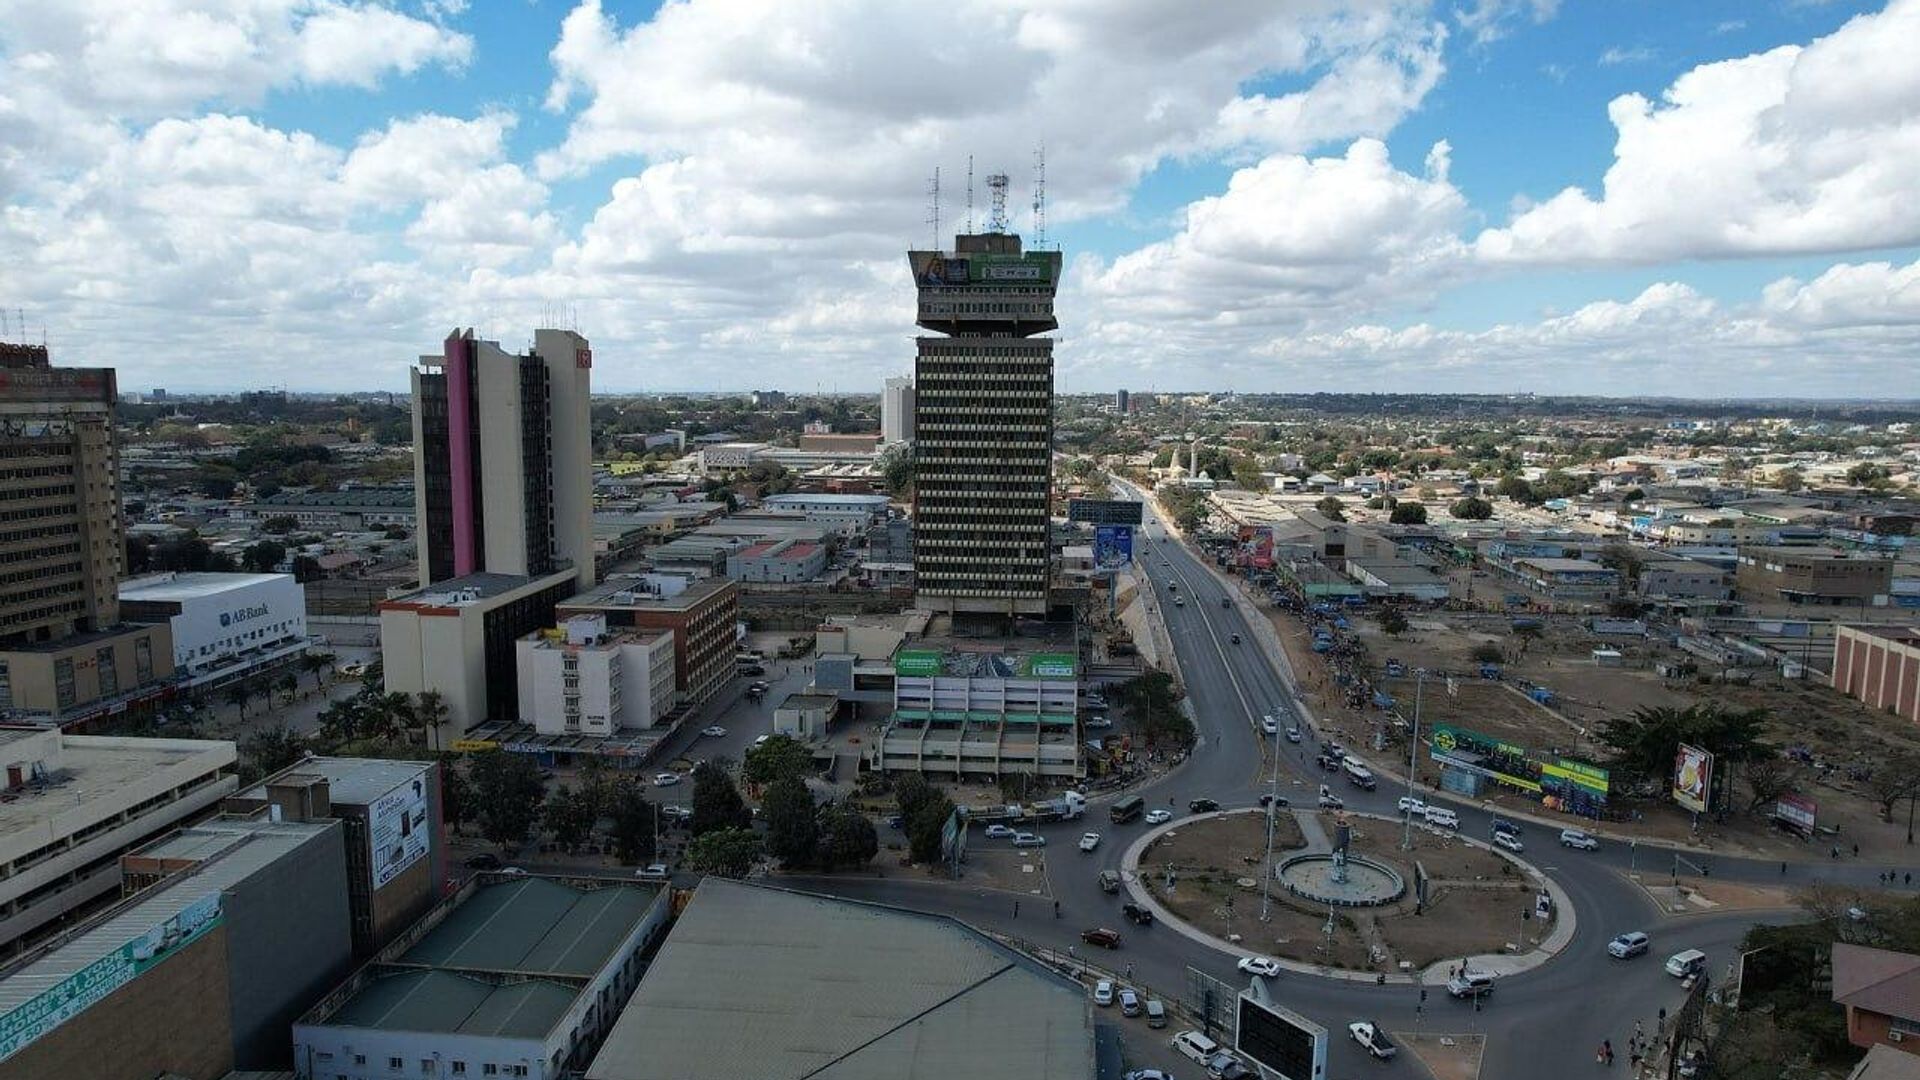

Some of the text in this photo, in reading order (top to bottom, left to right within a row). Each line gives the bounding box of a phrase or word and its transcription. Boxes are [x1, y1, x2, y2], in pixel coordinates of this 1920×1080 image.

[232, 602, 269, 624] AB Bank
[0, 976, 77, 1031] FURNISH
[83, 950, 129, 978] YOUR
[1, 1000, 54, 1037] HOME
[74, 958, 128, 995] LODGE
